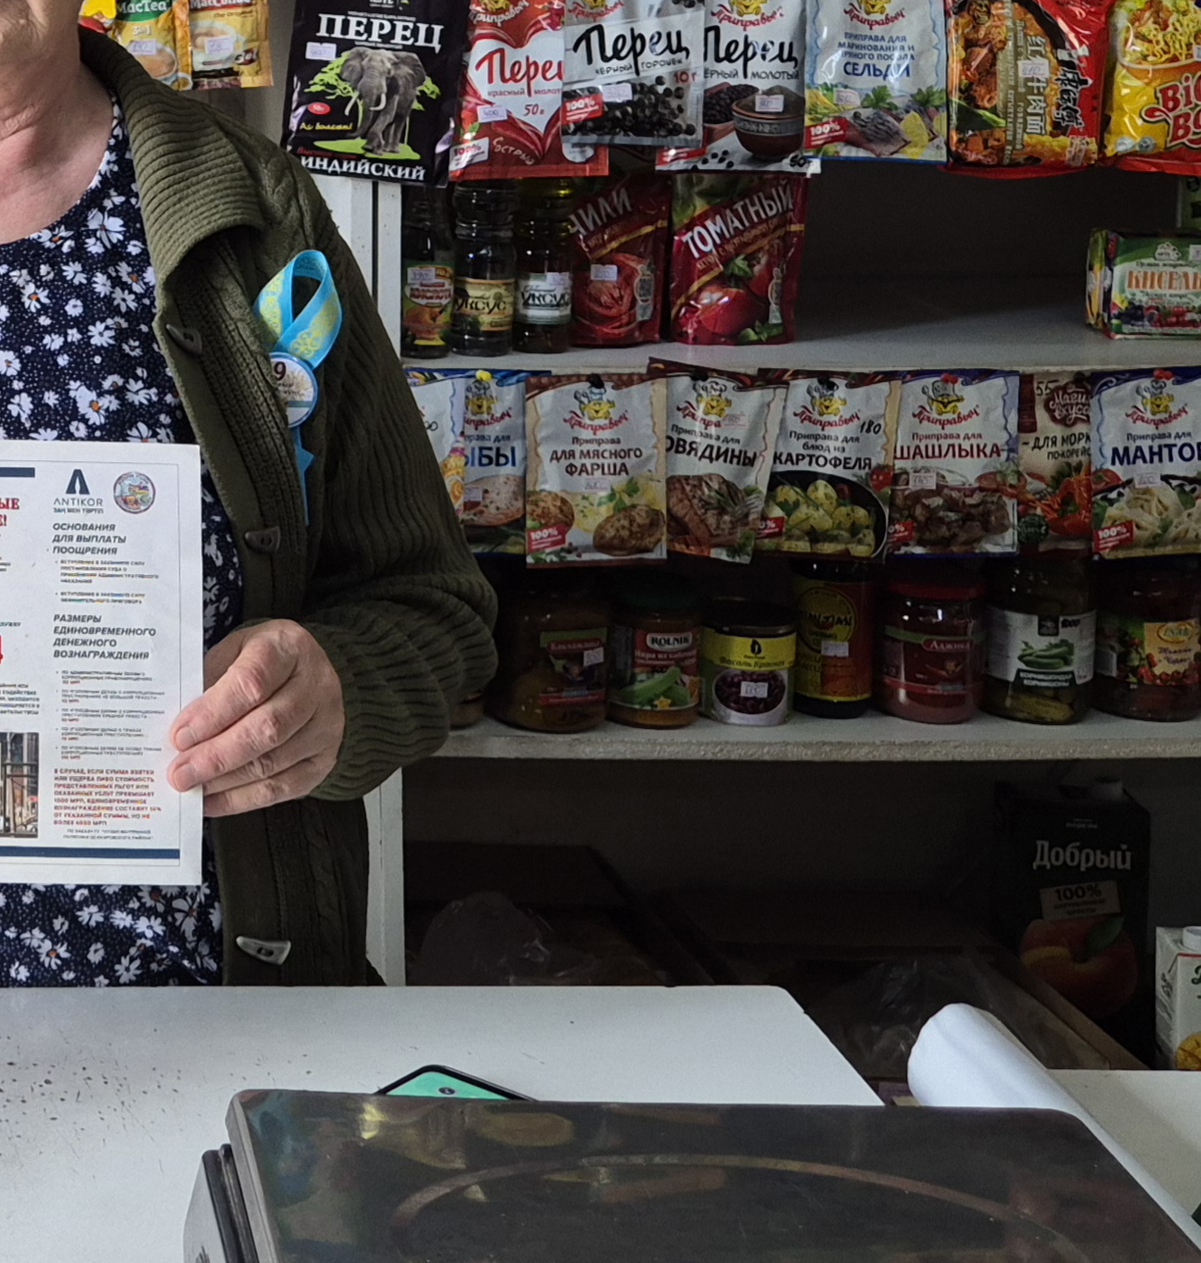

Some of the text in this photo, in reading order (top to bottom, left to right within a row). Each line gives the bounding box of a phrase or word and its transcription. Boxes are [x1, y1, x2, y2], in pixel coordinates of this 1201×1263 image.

[315, 13, 445, 53] ПЕРЕЦ
[572, 26, 691, 81] Перец
[301, 156, 427, 183] ИНДИЙСКИЙ
[682, 183, 796, 260] ТОМАТНЫЙ
[550, 446, 644, 464] ДЛЯ МЯСНОГО
[893, 443, 1001, 460] ШАШЛЫКА
[564, 461, 630, 478] ФАРША
[771, 451, 873, 472] КАРТОФЕЛЯ
[52, 521, 116, 533] ОСНОВАНИЯ
[51, 534, 127, 546] ДЛЯ ВЫПЛАТЫ
[52, 545, 118, 557] ПООЩРЕНИЯ
[52, 613, 102, 625] РАЗМЕРЫ
[52, 625, 157, 638] ЕДИНОВРЕМЕННОГО
[52, 637, 118, 650] ДЕНЕЖНОГО
[52, 649, 150, 662] ВОЗНАГРАЖДЕНИЯ
[1032, 841, 1133, 872] Добрый
